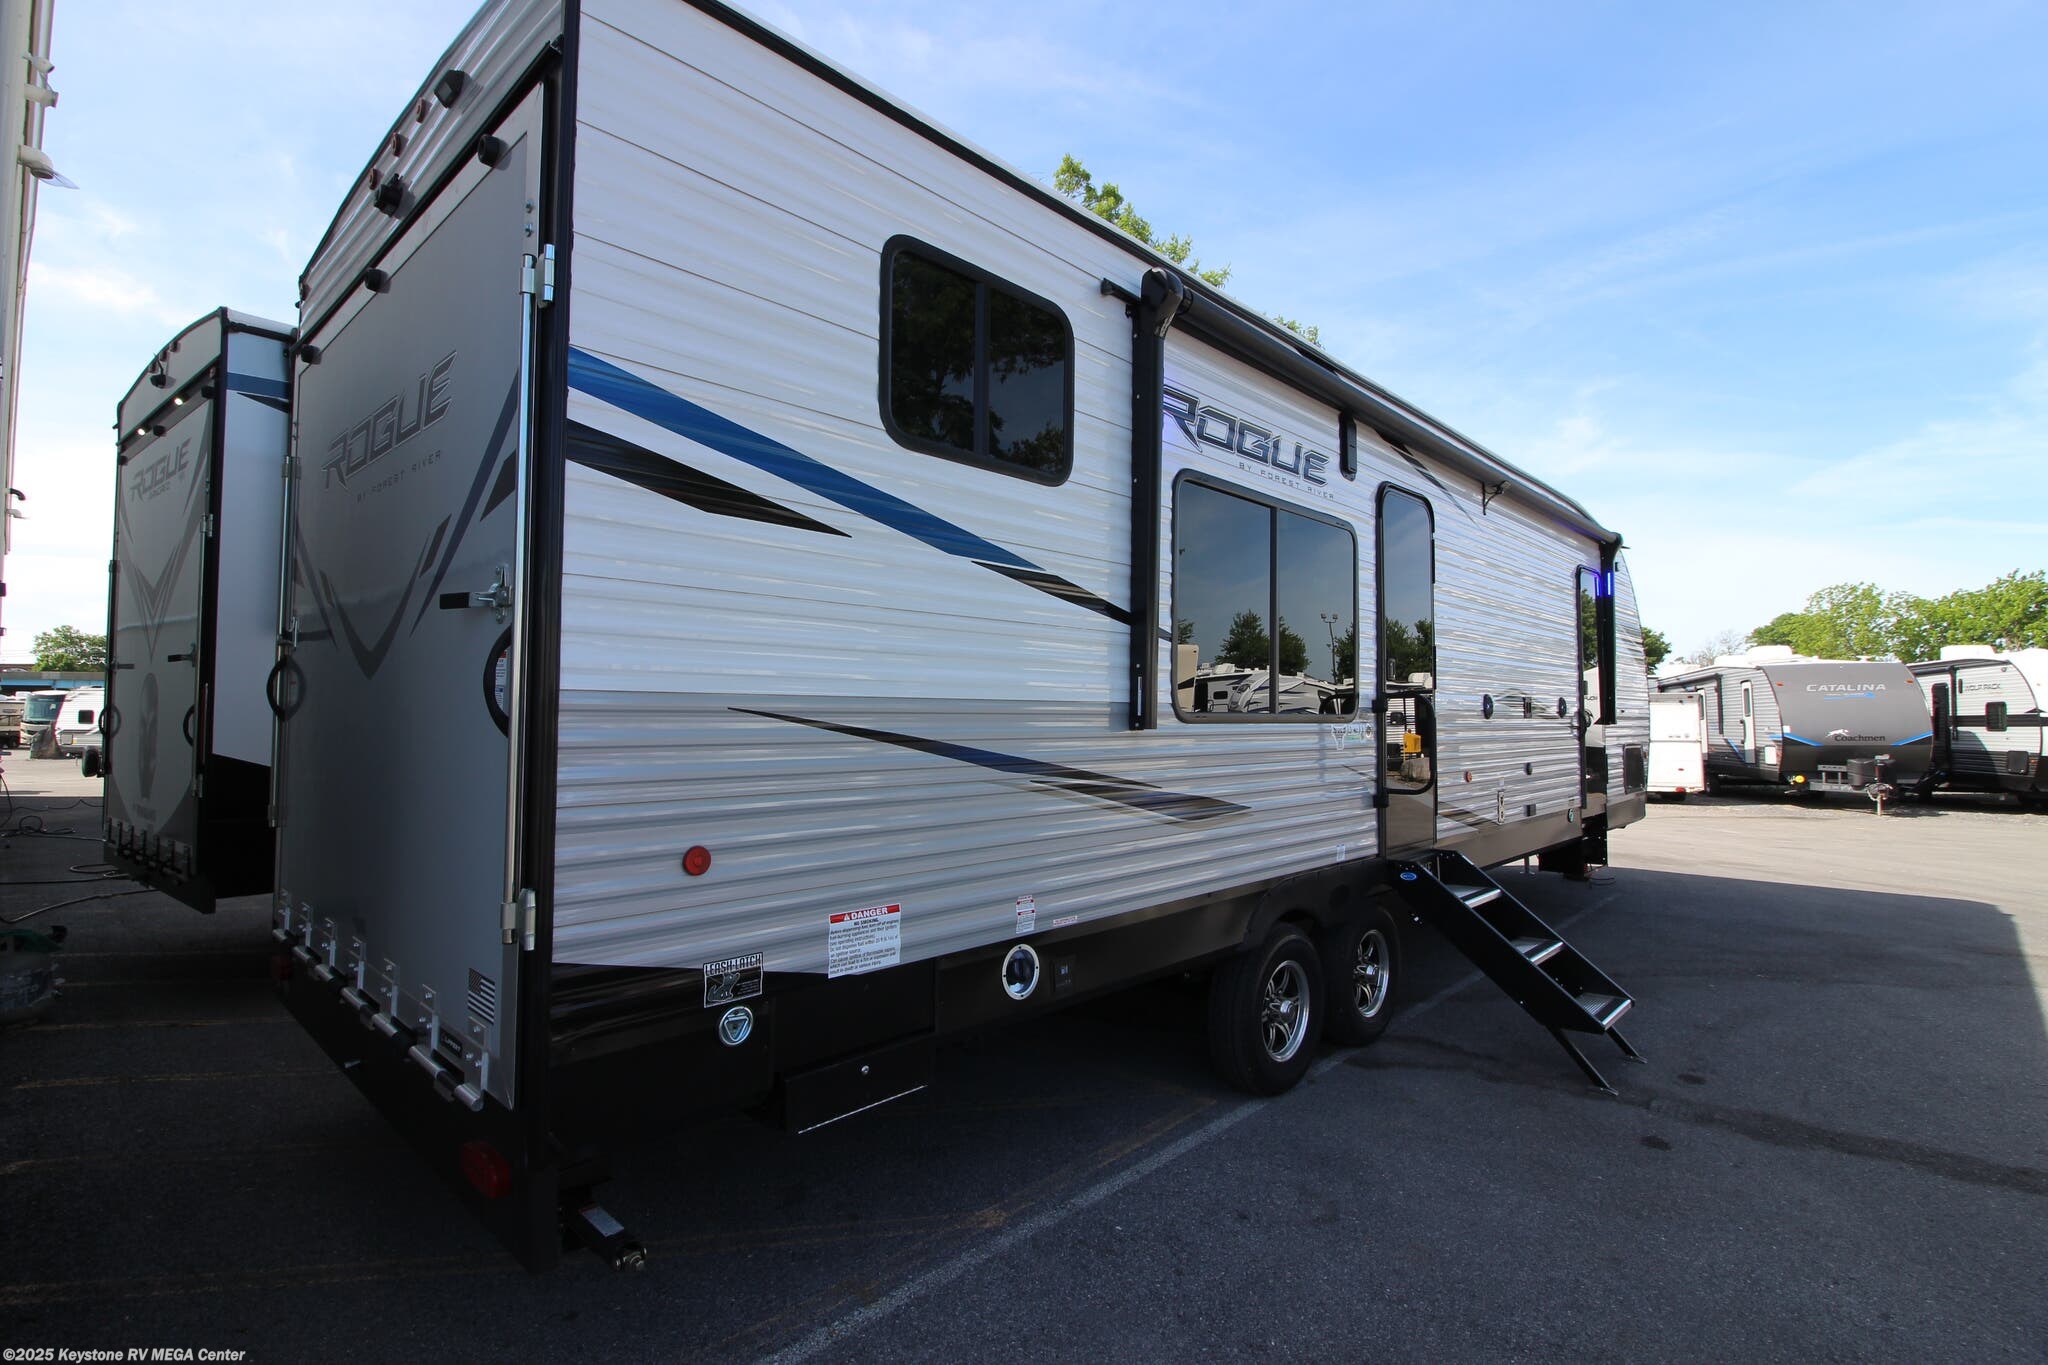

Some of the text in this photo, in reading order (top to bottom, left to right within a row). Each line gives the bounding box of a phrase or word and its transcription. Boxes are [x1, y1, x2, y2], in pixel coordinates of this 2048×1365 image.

[320, 350, 457, 491] ROGUE
[1163, 384, 1330, 487] ROGUE
[130, 437, 192, 502] ROGUE
[1239, 461, 1335, 500] BY FOREST RIVER
[1806, 683, 1886, 692] CATALINA
[851, 907, 889, 921] DANGER
